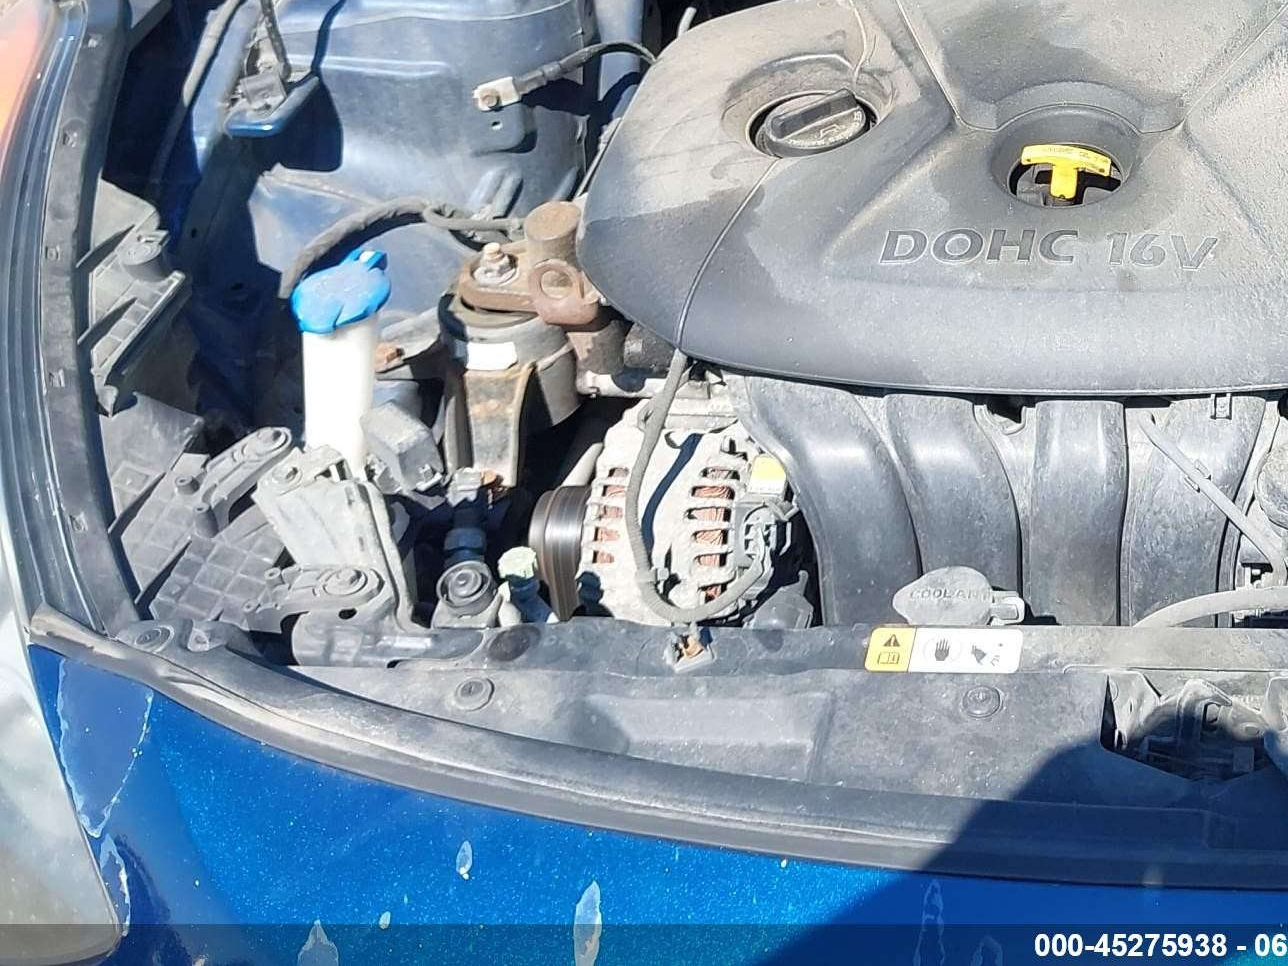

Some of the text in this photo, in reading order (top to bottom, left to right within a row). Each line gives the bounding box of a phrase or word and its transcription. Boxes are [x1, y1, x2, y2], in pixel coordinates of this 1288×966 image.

[879, 228, 1218, 271] DOHC 16V
[909, 587, 992, 603] COOLANT
